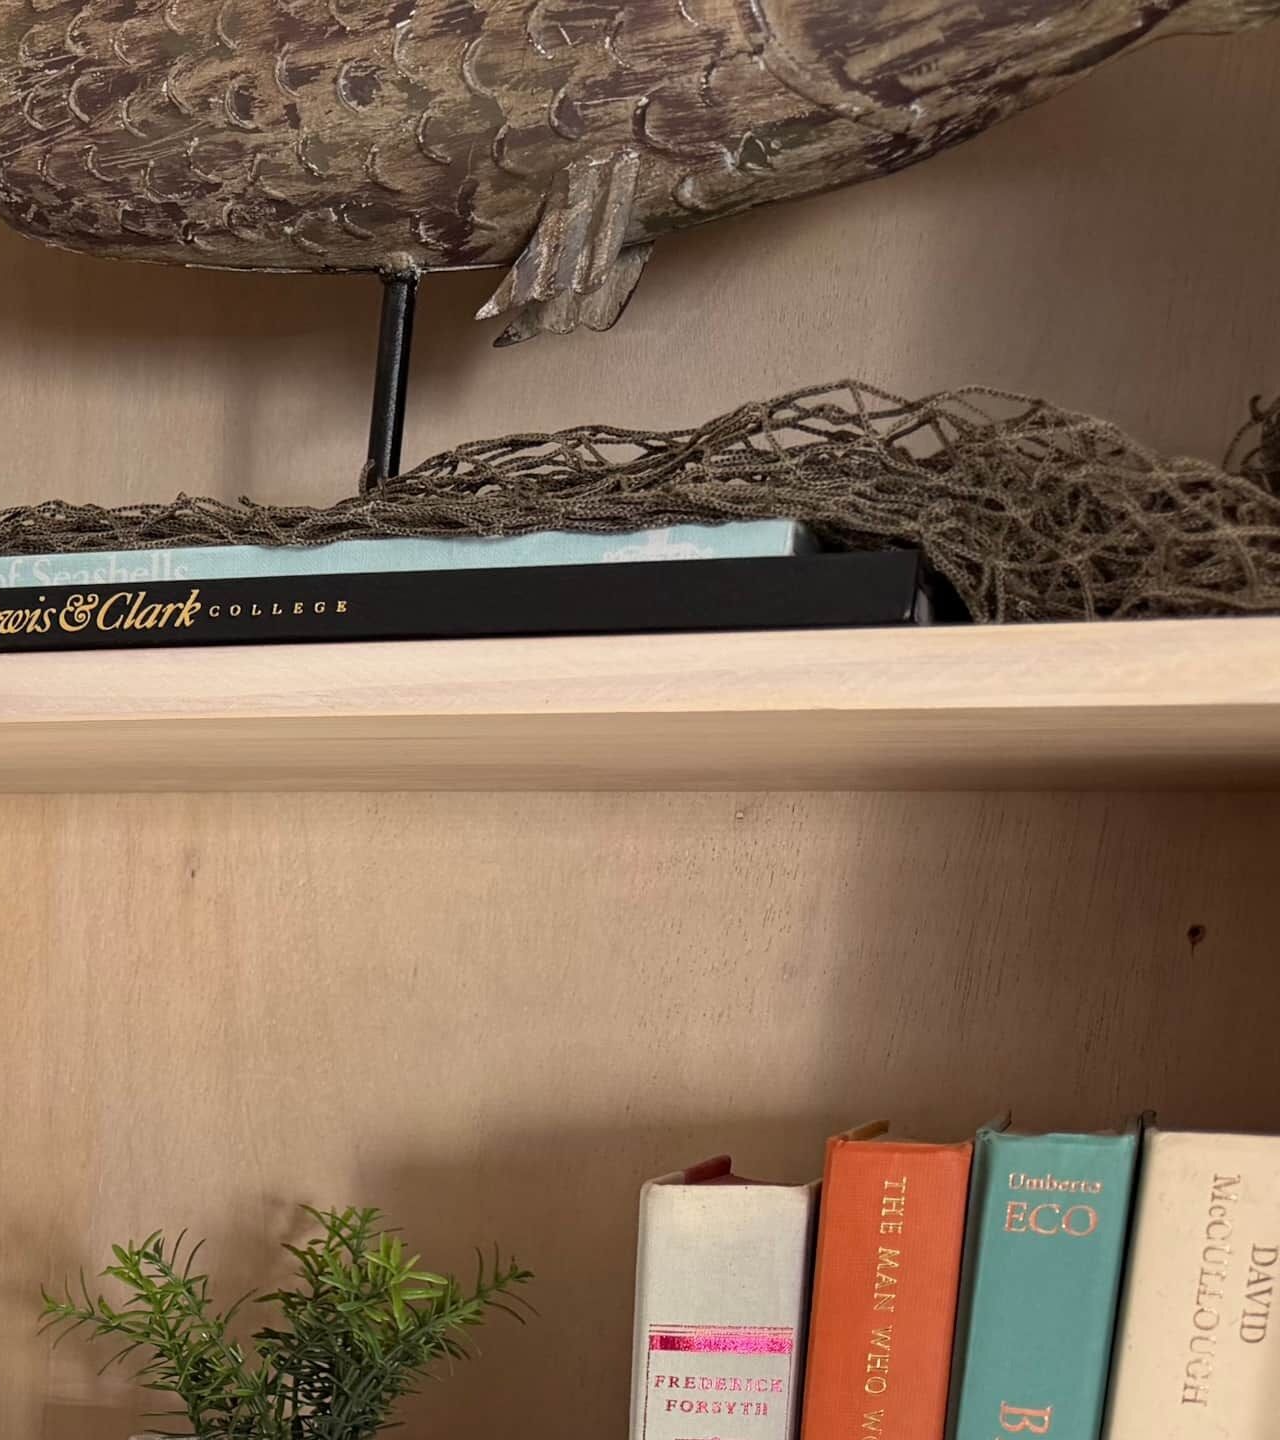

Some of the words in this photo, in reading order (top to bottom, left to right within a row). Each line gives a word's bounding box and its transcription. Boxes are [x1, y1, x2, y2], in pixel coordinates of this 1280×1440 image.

[96, 589, 202, 631] Clark
[208, 600, 349, 618] COLLEGE
[880, 1176, 907, 1235] THE
[1004, 1200, 1099, 1236] ECO
[873, 1245, 901, 1313] MAN
[1181, 1173, 1241, 1407] McCULLOUGH
[1239, 1243, 1279, 1344] DAVID
[654, 1375, 784, 1393] FREDERICK
[864, 1325, 893, 1395] WHO
[665, 1398, 769, 1416] FORSYTH
